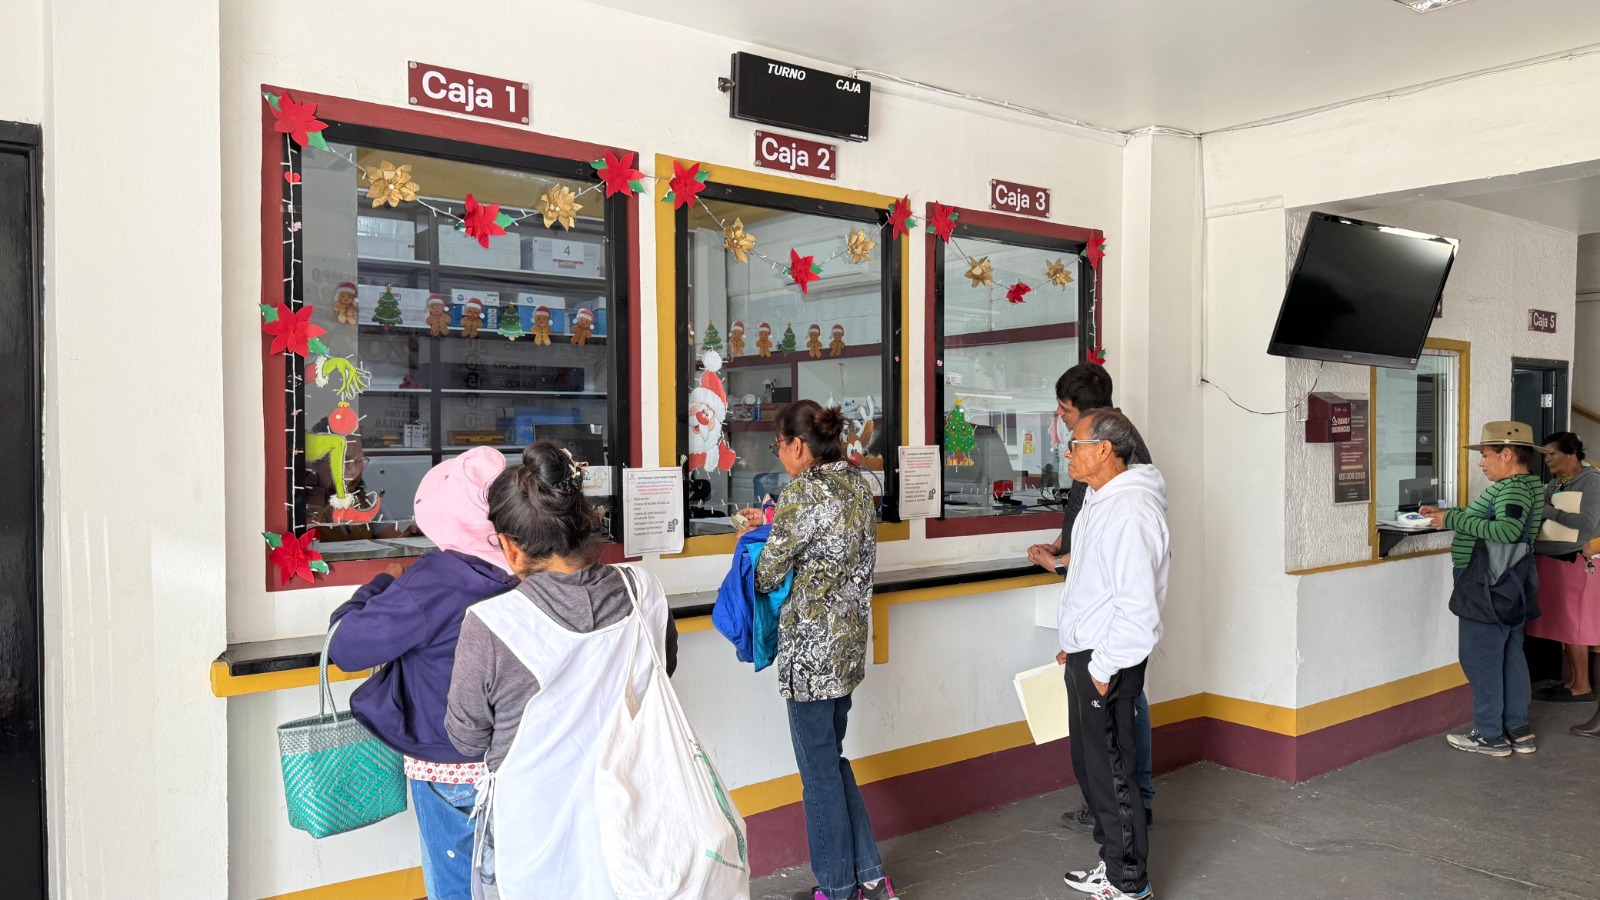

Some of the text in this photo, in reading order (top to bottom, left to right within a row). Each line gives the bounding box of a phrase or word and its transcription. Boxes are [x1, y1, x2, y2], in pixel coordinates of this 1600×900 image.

[422, 70, 516, 112] Caja 1
[768, 62, 861, 94] TURNO CAJA
[762, 136, 830, 171] Caja 2
[996, 184, 1046, 212] Caja 3
[563, 245, 571, 256] 4
[1533, 312, 1555, 330] Caja 5
